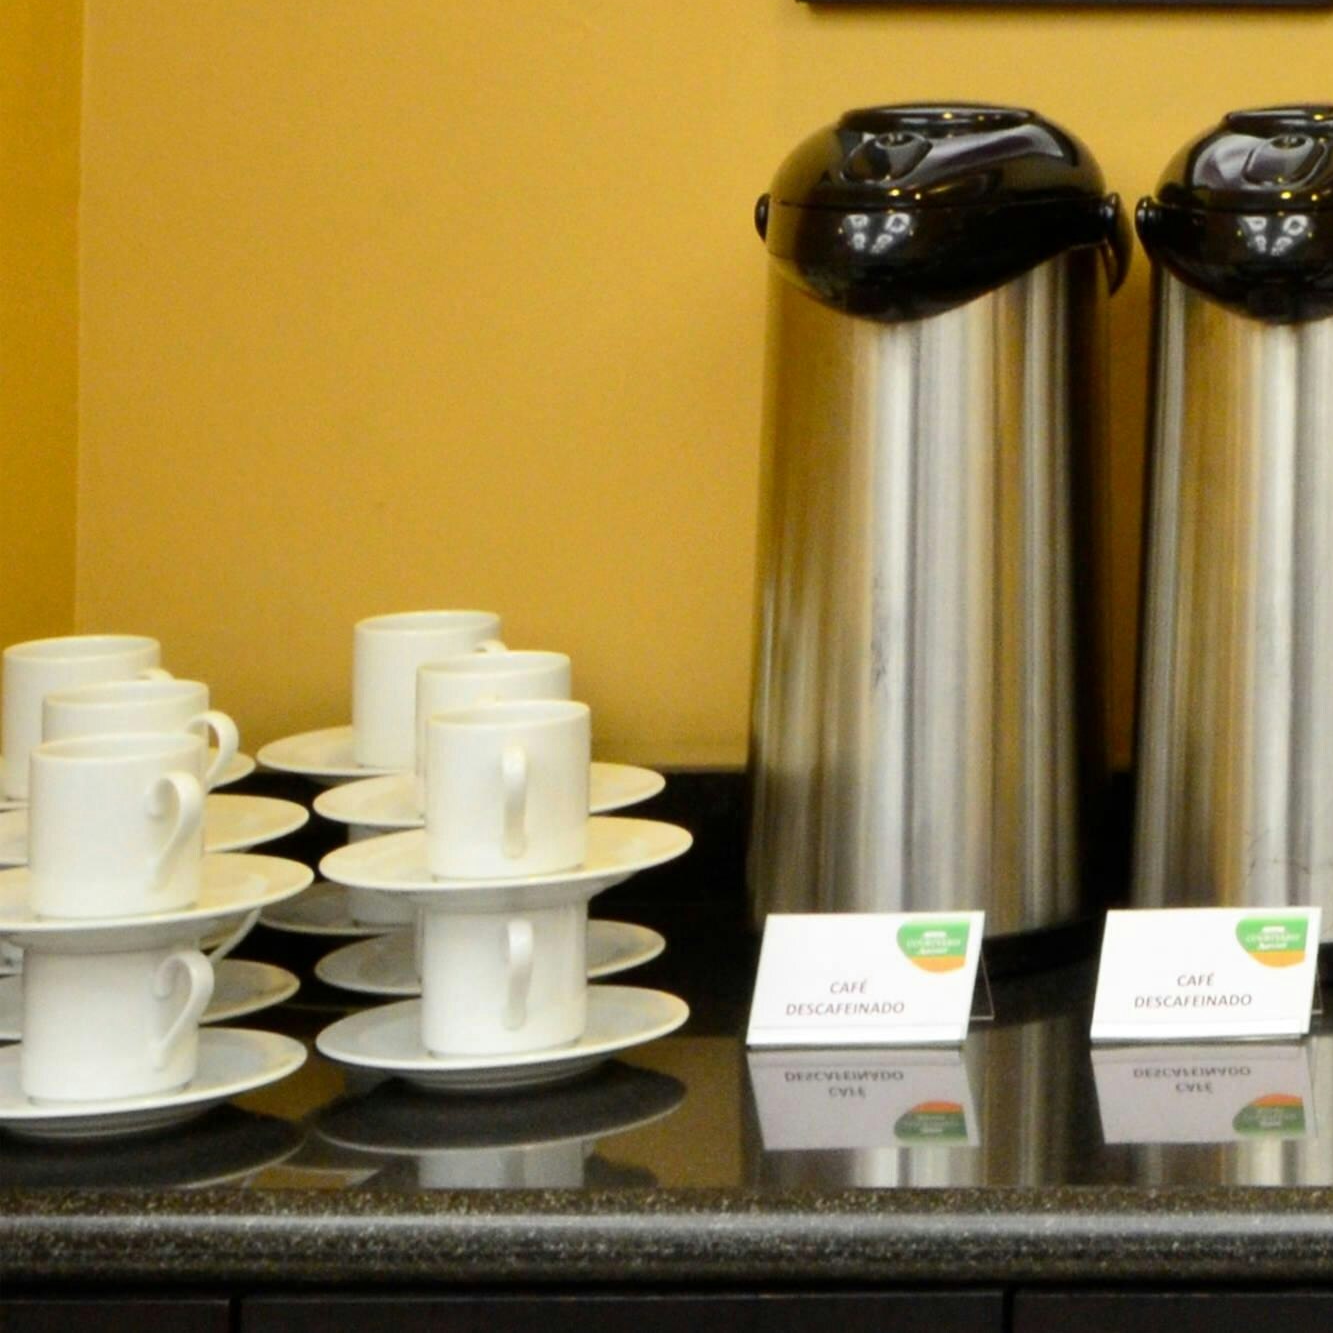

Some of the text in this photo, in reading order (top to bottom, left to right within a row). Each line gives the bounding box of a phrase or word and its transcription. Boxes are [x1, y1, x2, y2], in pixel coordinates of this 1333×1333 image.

[829, 979, 867, 994] CAFÉ
[1176, 972, 1215, 987] CAFÉ
[1134, 993, 1253, 1008] DESCAFEINADO
[785, 1002, 905, 1016] DESCAFEINADO
